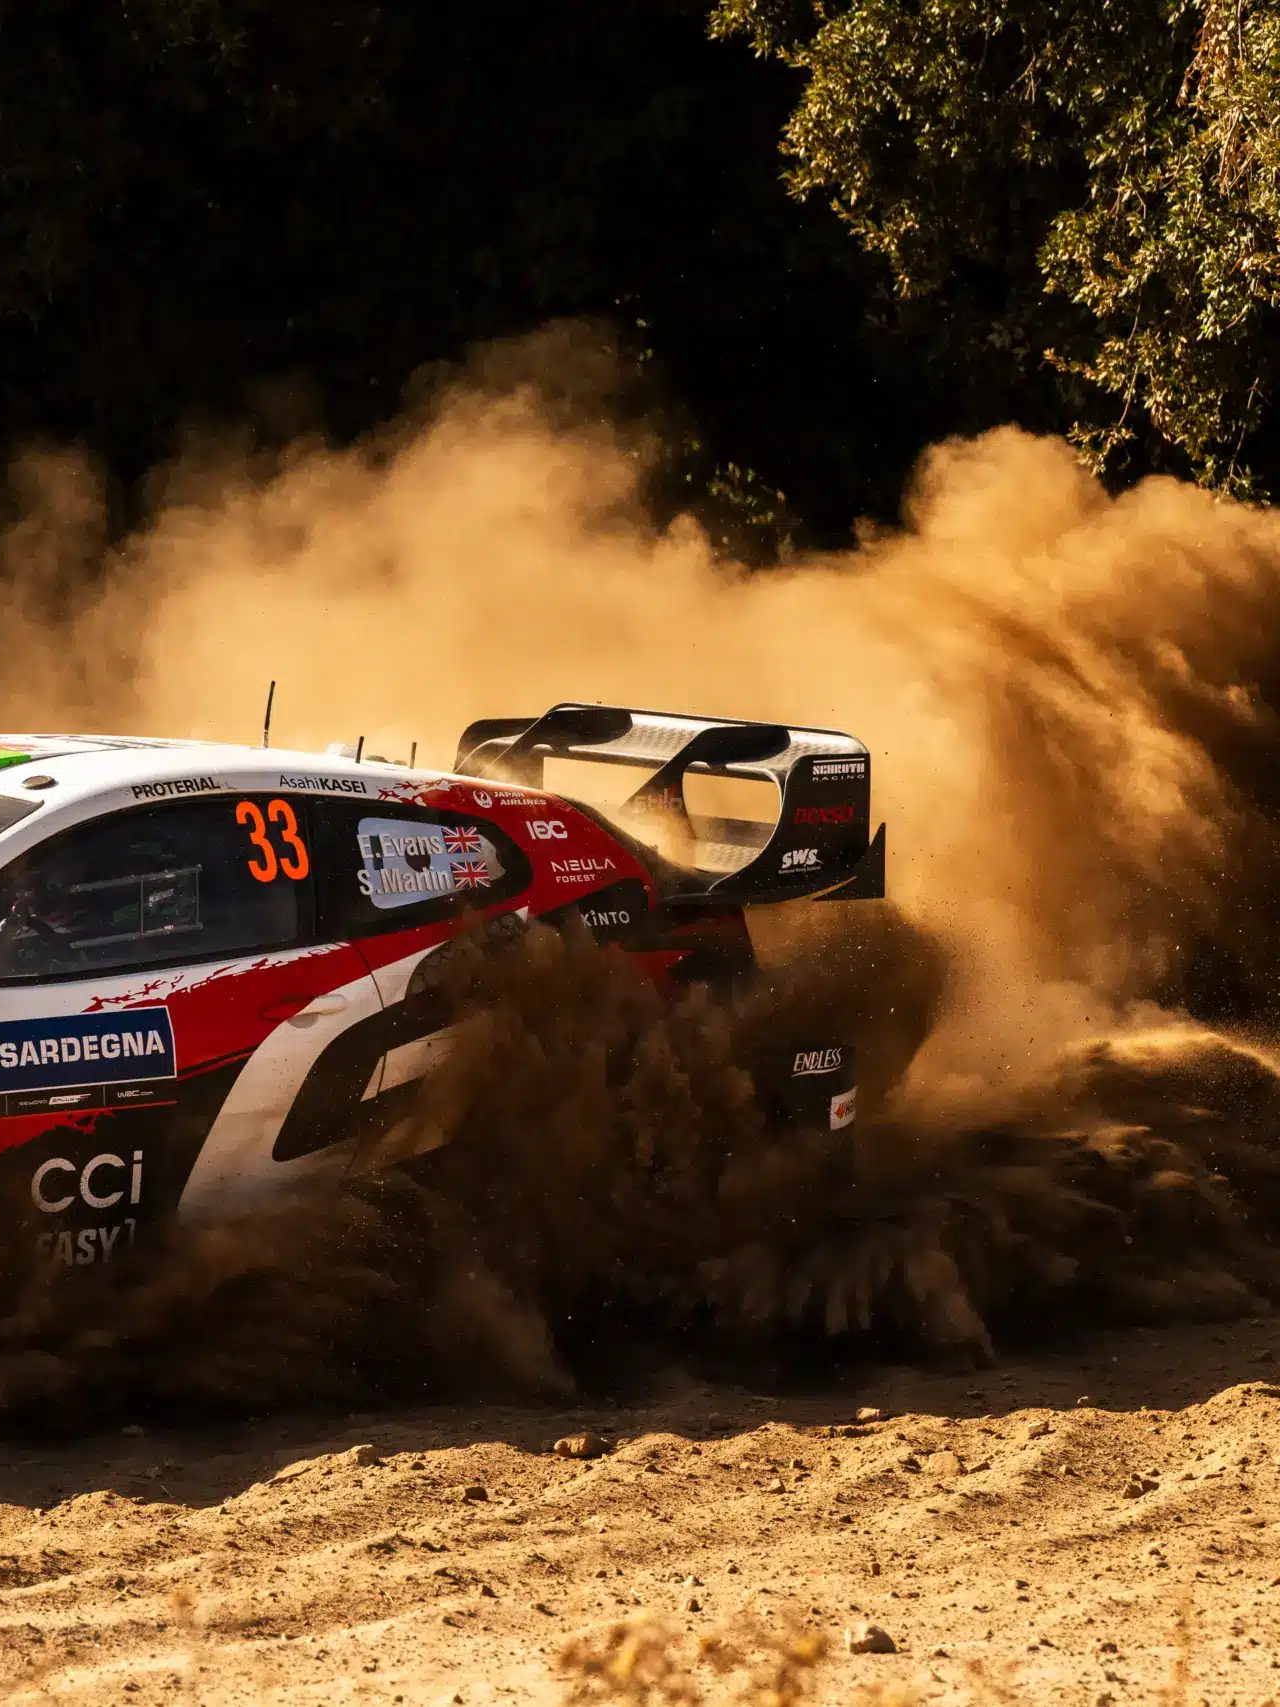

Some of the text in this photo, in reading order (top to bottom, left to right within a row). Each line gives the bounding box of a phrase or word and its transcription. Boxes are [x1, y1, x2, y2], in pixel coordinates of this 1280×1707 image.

[812, 763, 865, 775] SCHROTH
[812, 774, 865, 782] RACING
[131, 776, 221, 799] PROTERIAL
[793, 807, 856, 824] DENSO
[235, 799, 309, 883] 33
[357, 833, 443, 859] E.Evans
[781, 848, 819, 869] SWS
[356, 866, 451, 896] S.Martin
[556, 874, 596, 884] FOREST
[0, 1030, 166, 1068] SARDEGNA
[793, 1047, 842, 1072] ENDLESS
